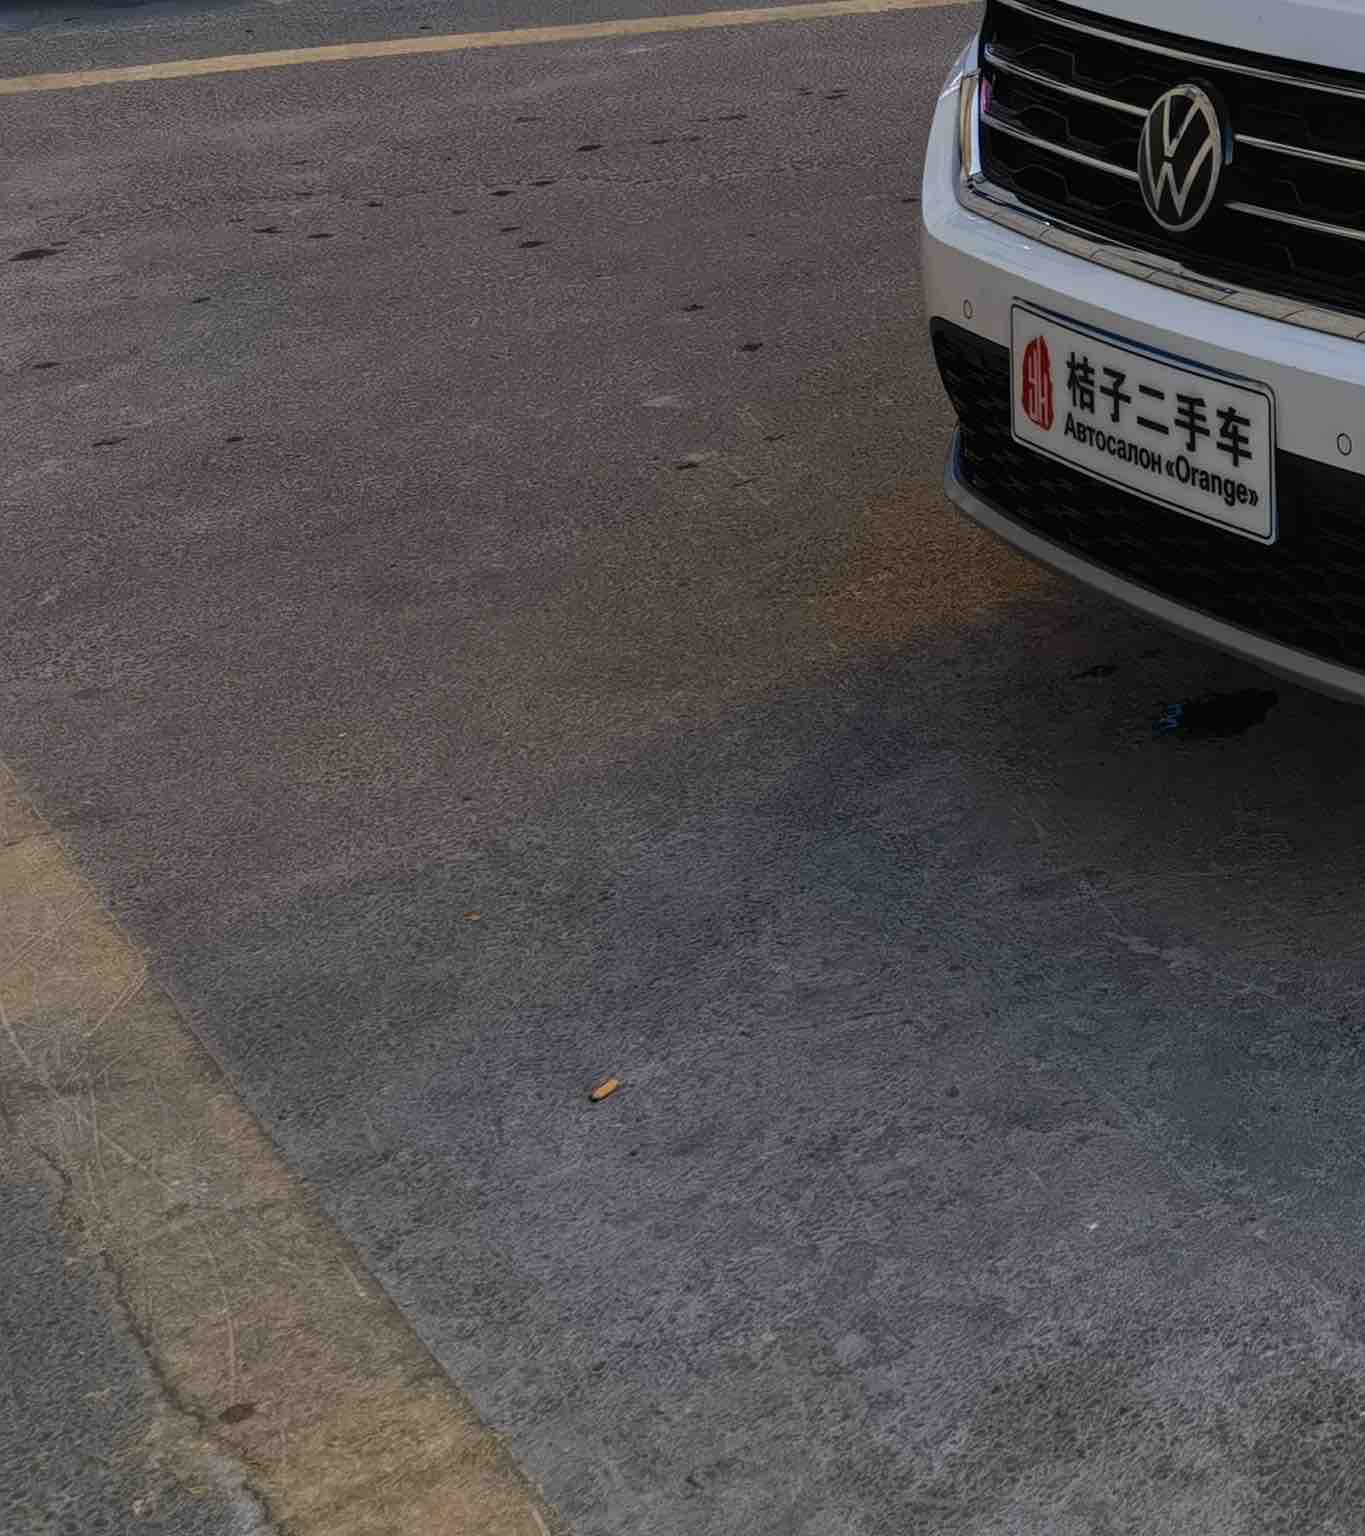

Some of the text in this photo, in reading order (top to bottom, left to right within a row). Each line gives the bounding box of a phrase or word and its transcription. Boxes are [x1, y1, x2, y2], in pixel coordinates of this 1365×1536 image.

[1064, 413, 1259, 507] Автосалон «Orange»
[1066, 352, 1253, 467] 桔子二手车
